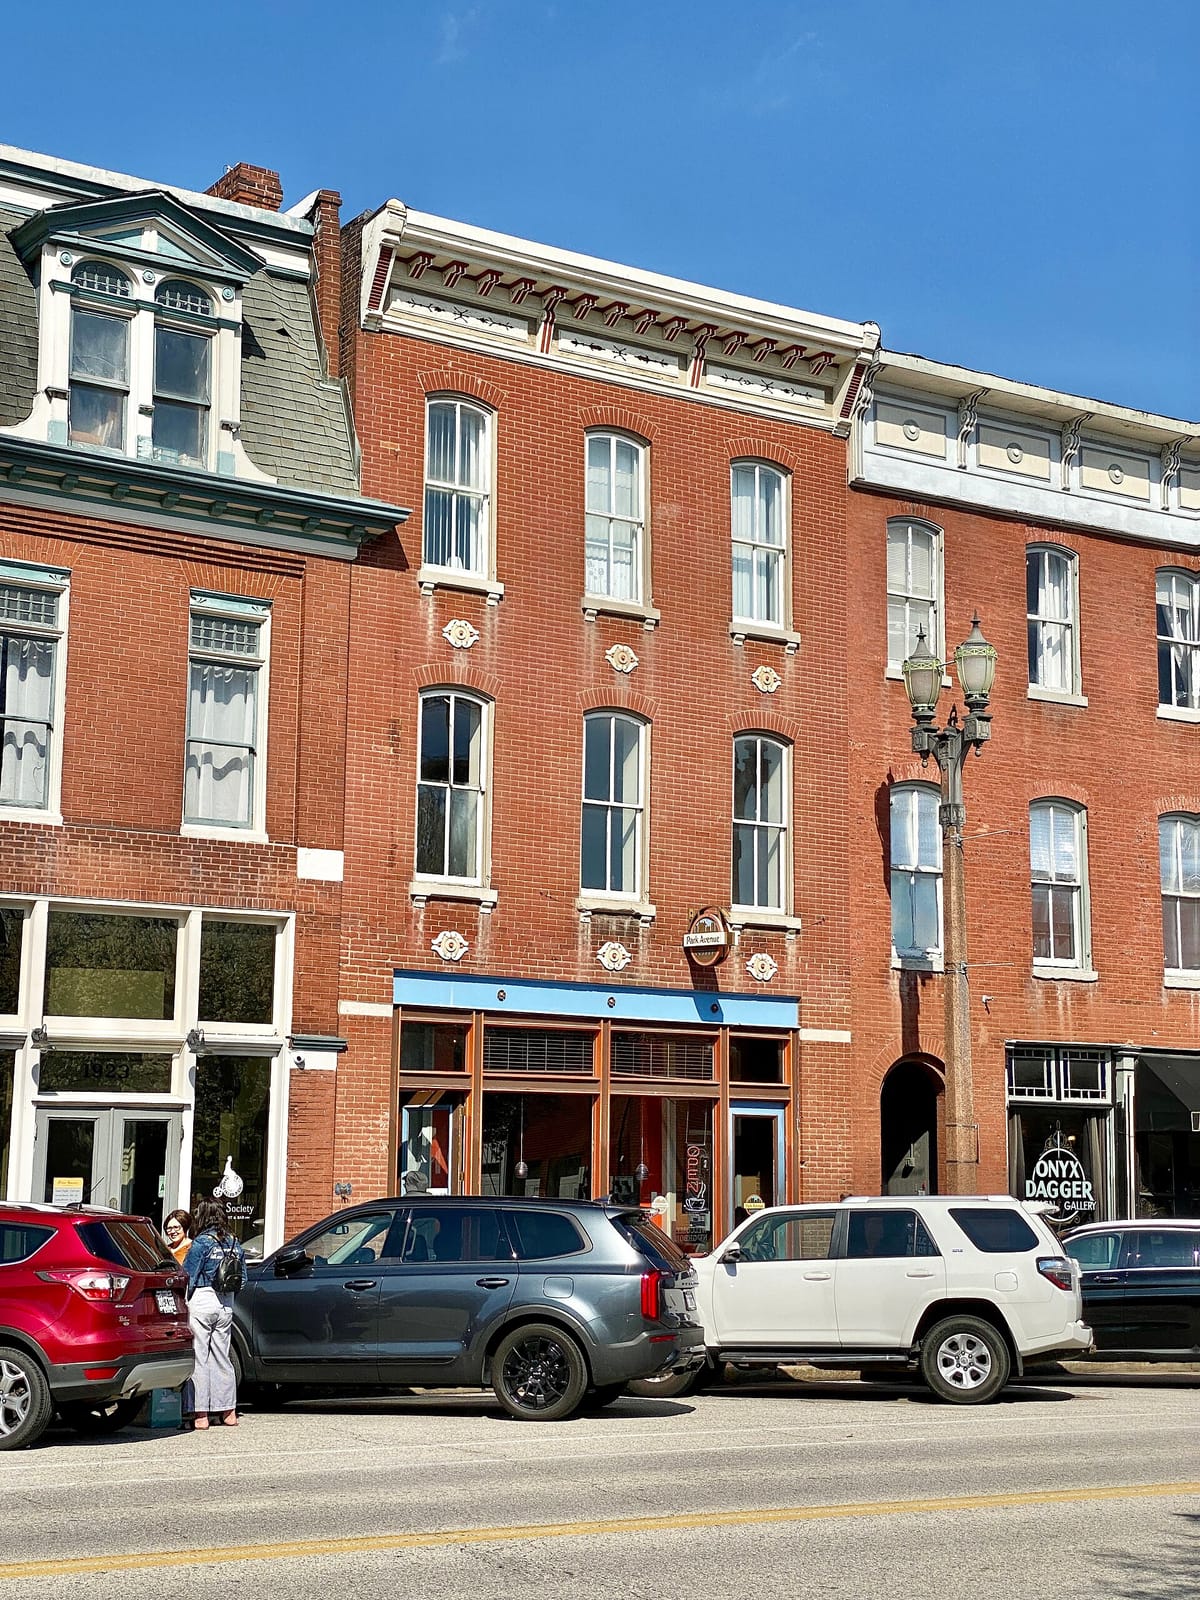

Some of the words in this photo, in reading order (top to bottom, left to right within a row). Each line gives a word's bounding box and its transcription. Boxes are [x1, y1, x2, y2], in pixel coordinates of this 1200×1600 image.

[686, 935, 699, 945] Park
[700, 935, 720, 944] Avenue
[84, 1062, 129, 1079] 1923
[1035, 1159, 1080, 1178] ONYX
[1025, 1180, 1095, 1201] DAGGER
[225, 1201, 255, 1215] Society
[1063, 1200, 1097, 1211] GALLERY
